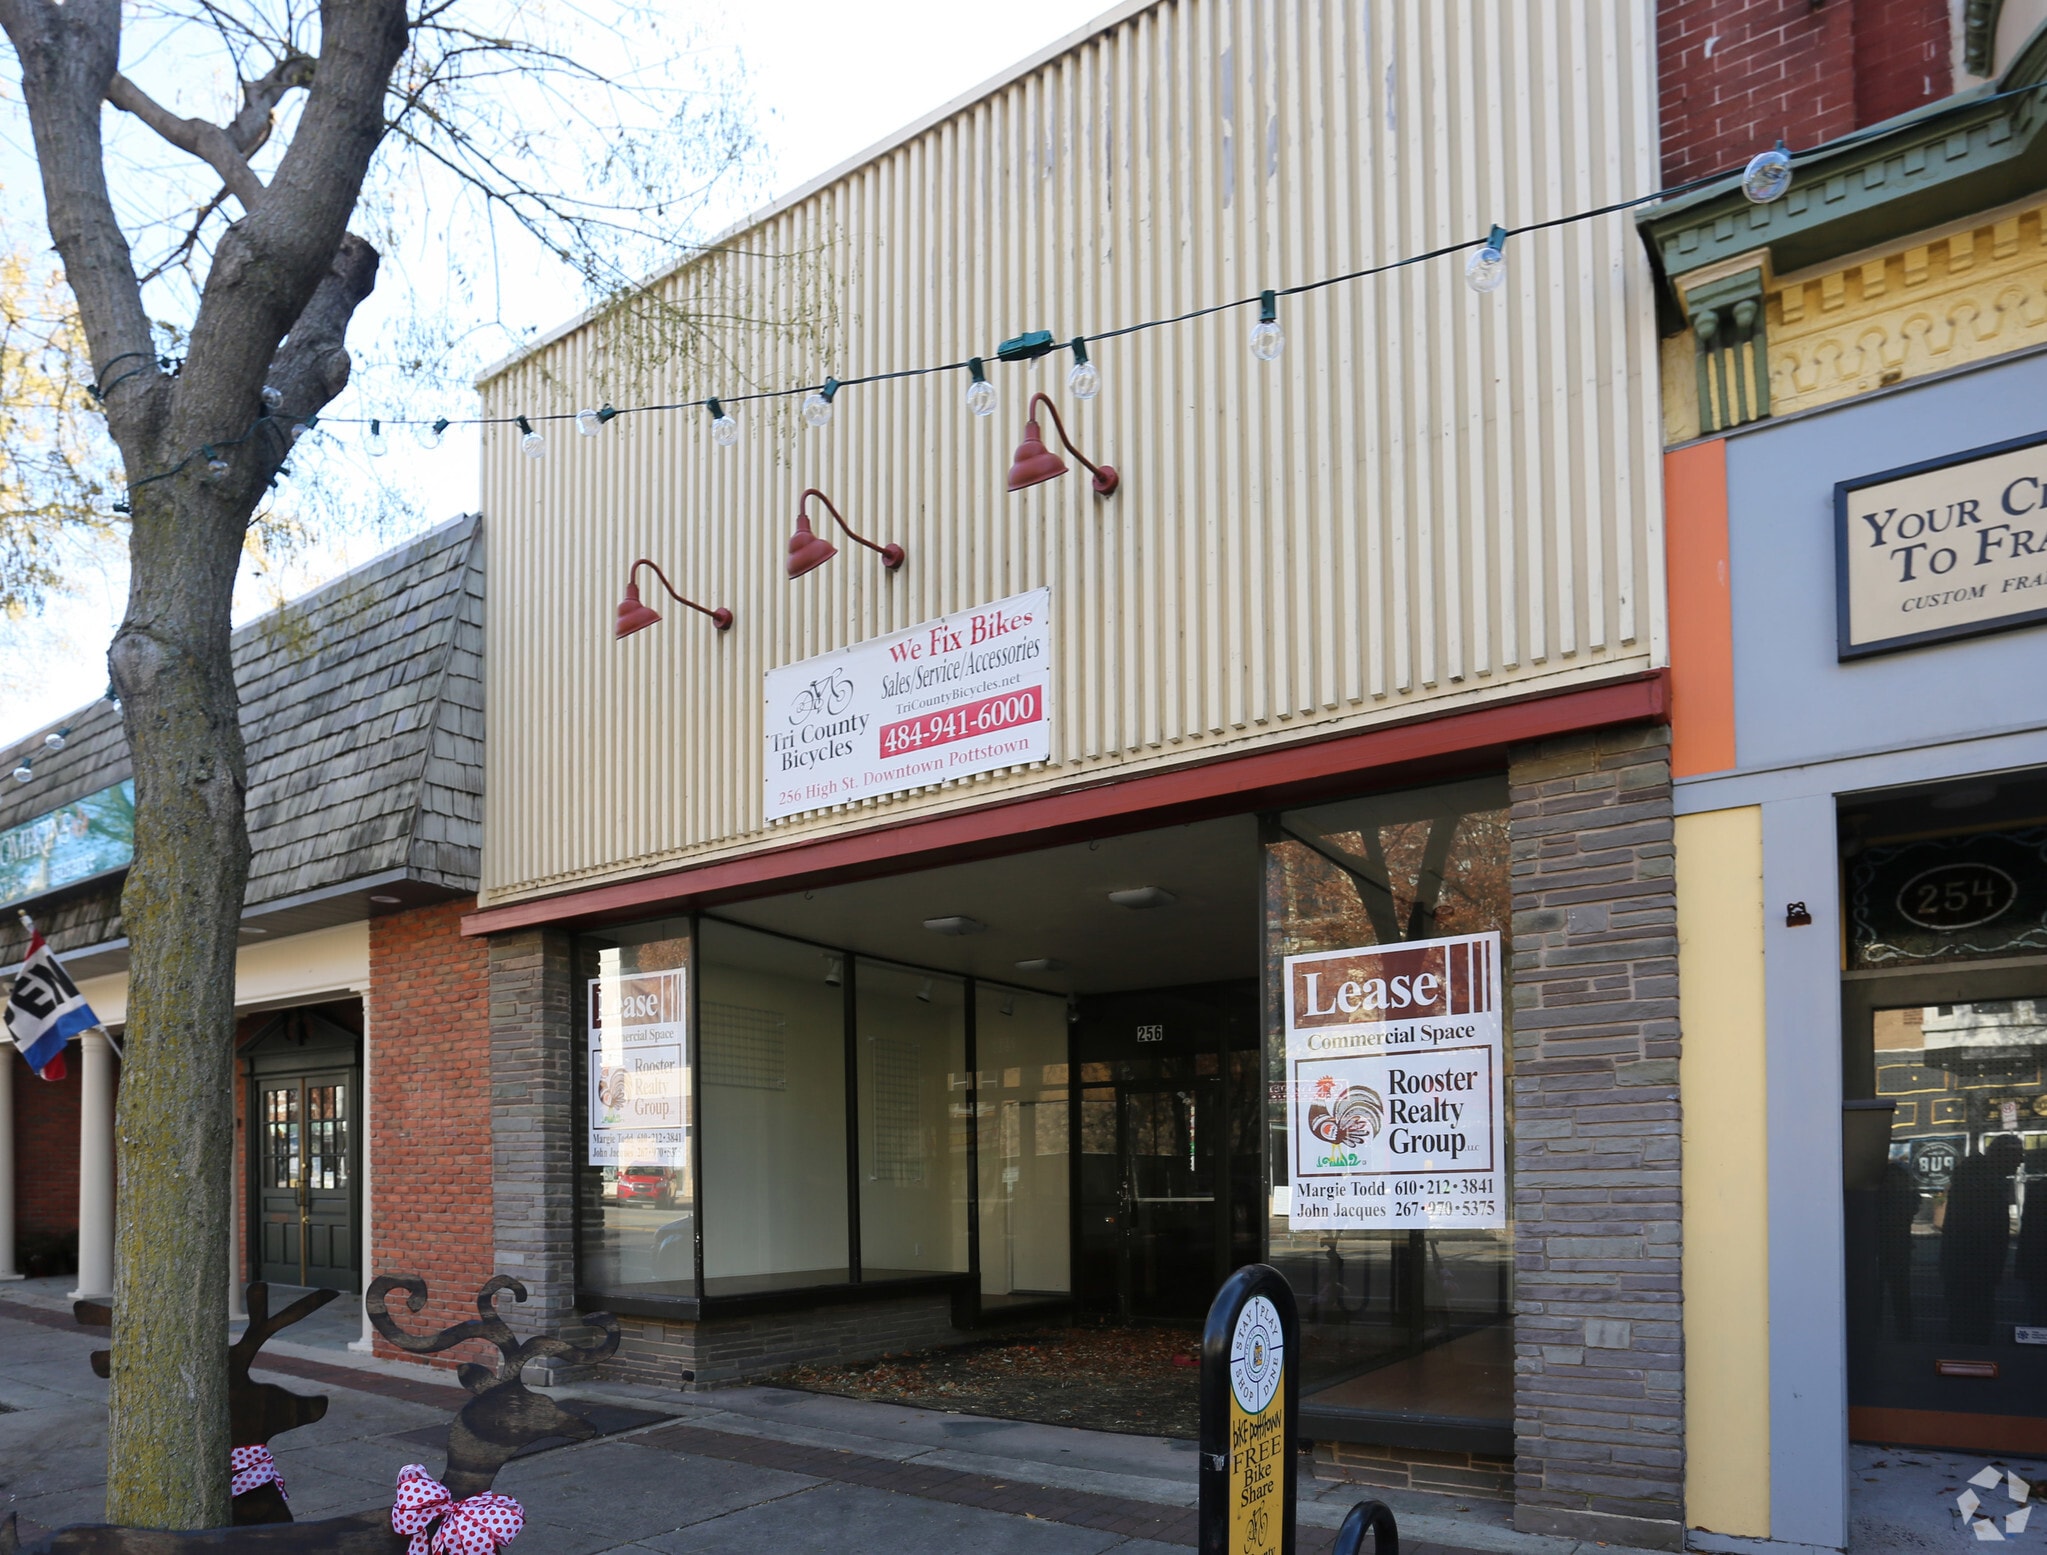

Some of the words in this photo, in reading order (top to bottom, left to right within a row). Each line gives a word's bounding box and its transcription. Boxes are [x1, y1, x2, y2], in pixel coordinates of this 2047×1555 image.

[1862, 499, 1982, 548] YOUR
[1890, 543, 1957, 583] TO
[1902, 584, 1988, 613] CUSTOM
[889, 638, 921, 663] We
[929, 624, 963, 656] Fix
[970, 611, 1033, 646] Bikes
[896, 673, 1022, 715] TriCountyBicycles.net
[771, 733, 795, 753] Tri
[801, 712, 870, 746] County
[884, 692, 1034, 754] 484-941-6000
[779, 791, 802, 806] 256
[805, 781, 838, 800] High
[842, 777, 859, 790] St.
[863, 757, 944, 787] Downtown
[949, 738, 1030, 768] Pottstown
[781, 738, 853, 772] Bicycles
[1917, 878, 1995, 915] 254
[1302, 970, 1439, 1018] Lease
[1138, 1025, 1161, 1041] 256
[1307, 1026, 1415, 1051] Commercial
[1420, 1024, 1476, 1046] Space
[1388, 1069, 1478, 1095] Rooster
[634, 1097, 670, 1120] Group
[1389, 1096, 1464, 1129] Realty
[1297, 1182, 1346, 1201] Margie
[1350, 1181, 1385, 1196] Todd
[1297, 1203, 1329, 1218] John
[1333, 1203, 1386, 1221] Jacques
[1235, 1309, 1252, 1350] STAY
[1259, 1305, 1279, 1336] PLAY
[1235, 1368, 1254, 1402] SHOP
[1263, 1357, 1279, 1396] DINE
[1232, 1435, 1282, 1475] FREE
[1244, 1463, 1272, 1488] Bike
[1241, 1480, 1274, 1508] Share
